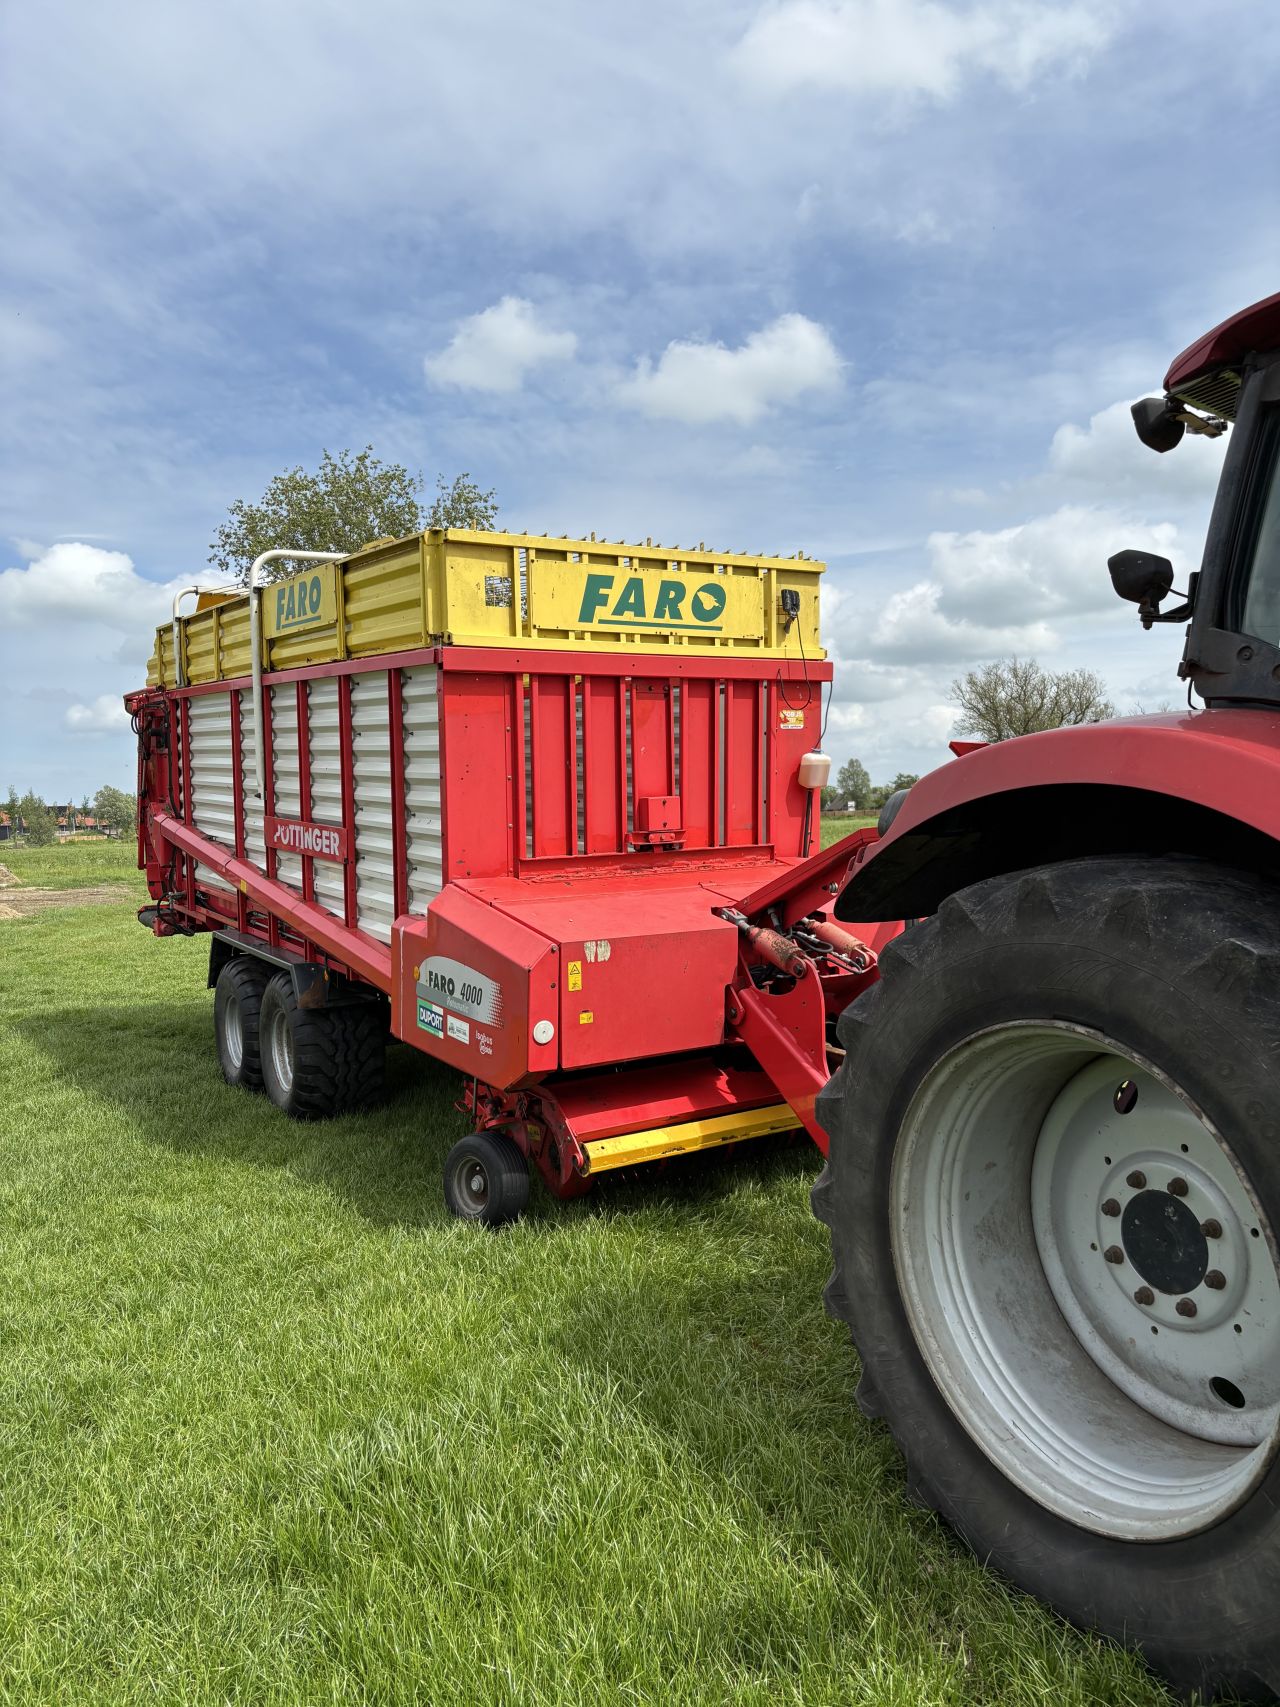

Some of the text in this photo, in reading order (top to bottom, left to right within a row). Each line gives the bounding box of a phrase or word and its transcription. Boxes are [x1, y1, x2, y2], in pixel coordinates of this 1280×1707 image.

[275, 575, 321, 630] FARO
[577, 573, 727, 623] FARO
[428, 970, 455, 996] FARO
[460, 982, 483, 1006] 4000
[419, 1007, 443, 1030] DUPORT
